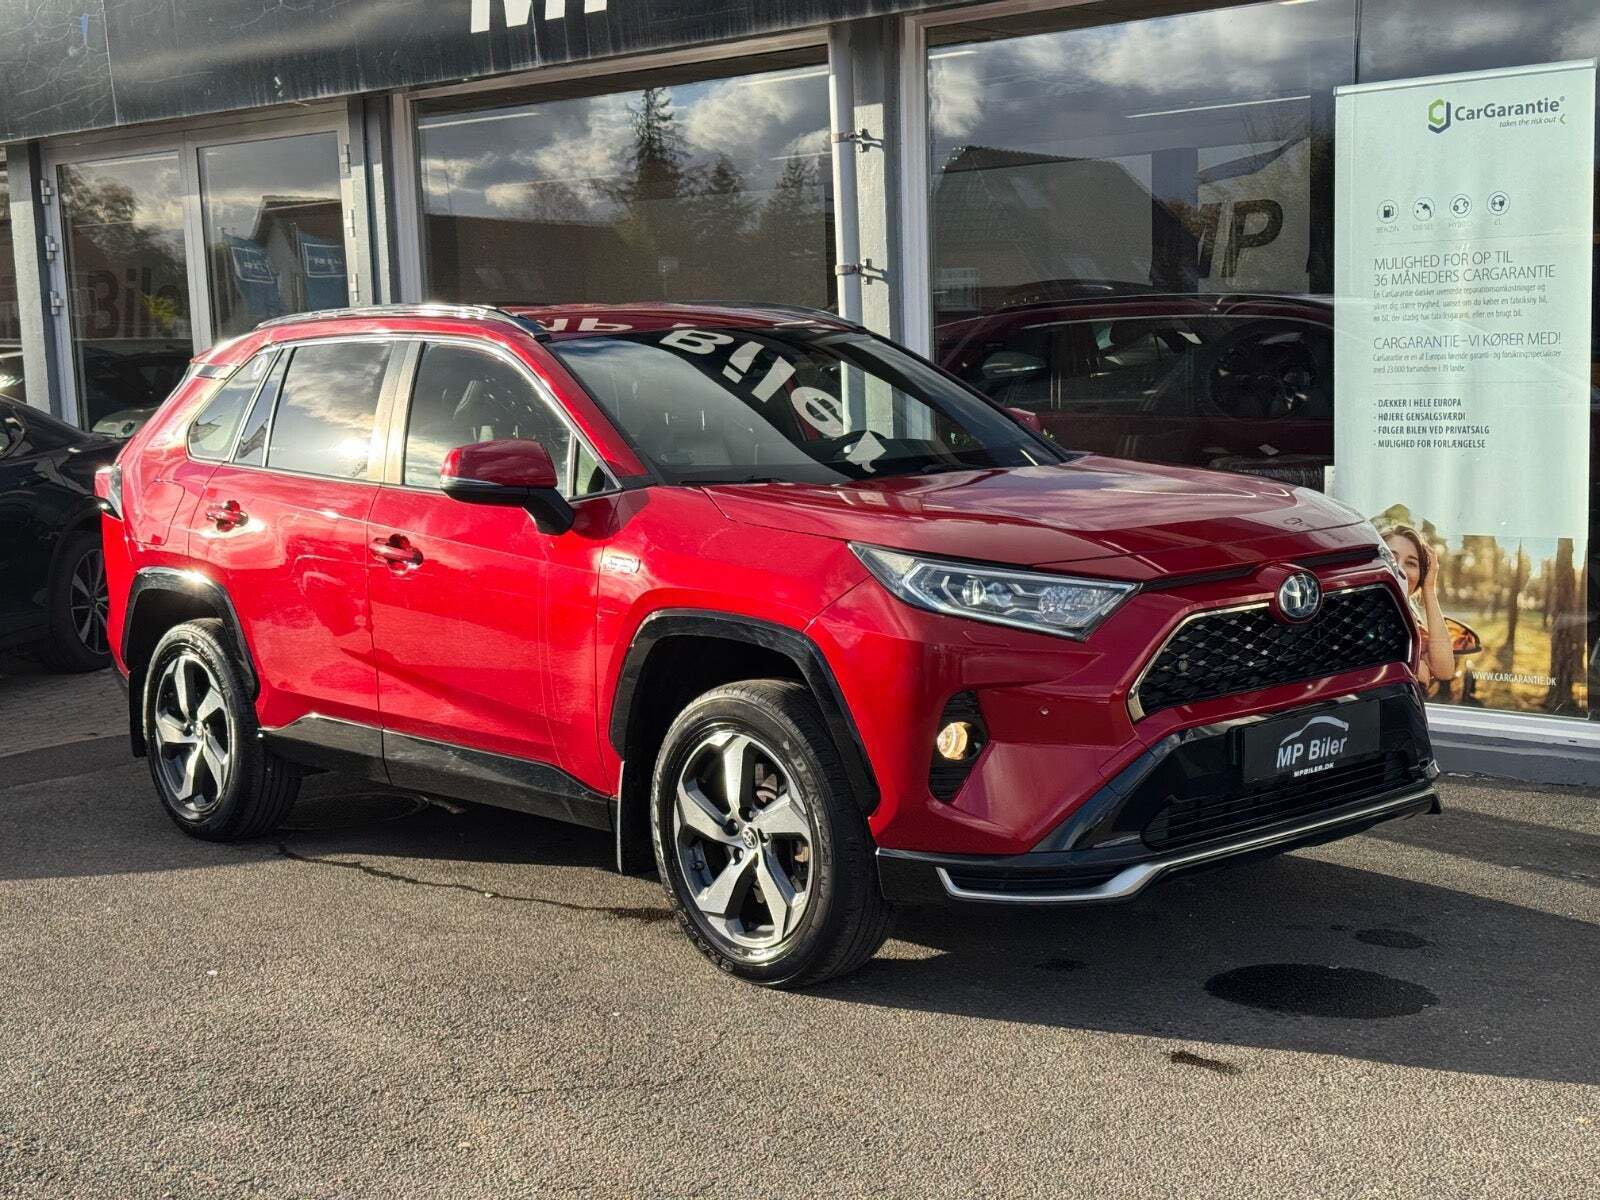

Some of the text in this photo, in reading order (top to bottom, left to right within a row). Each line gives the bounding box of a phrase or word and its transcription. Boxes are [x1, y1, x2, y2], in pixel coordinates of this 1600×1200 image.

[1519, 118, 1530, 126] the
[1374, 250, 1513, 270] MULIGHED FOR OP TIL
[1374, 265, 1557, 287] 36 MÅNEDERS CARGARANTIE
[1483, 332, 1524, 347] KØRER
[1528, 331, 1562, 346] MED!
[1378, 399, 1407, 407] DÆKKER
[1413, 398, 1432, 407] HELE
[1433, 398, 1461, 407] EUROPA
[1378, 412, 1466, 421] HØJERE GENSALGSVÆRDI
[1378, 425, 1490, 434] FØLGER BILEN VED PRIVATSALG
[1378, 439, 1486, 448] MULIGHED FOR FORLÆNGELSE
[1471, 671, 1557, 686] WWW.CARGARANTIE.DK
[1276, 736, 1348, 769] MP Biler
[1293, 762, 1335, 777] MPBILER.DK
